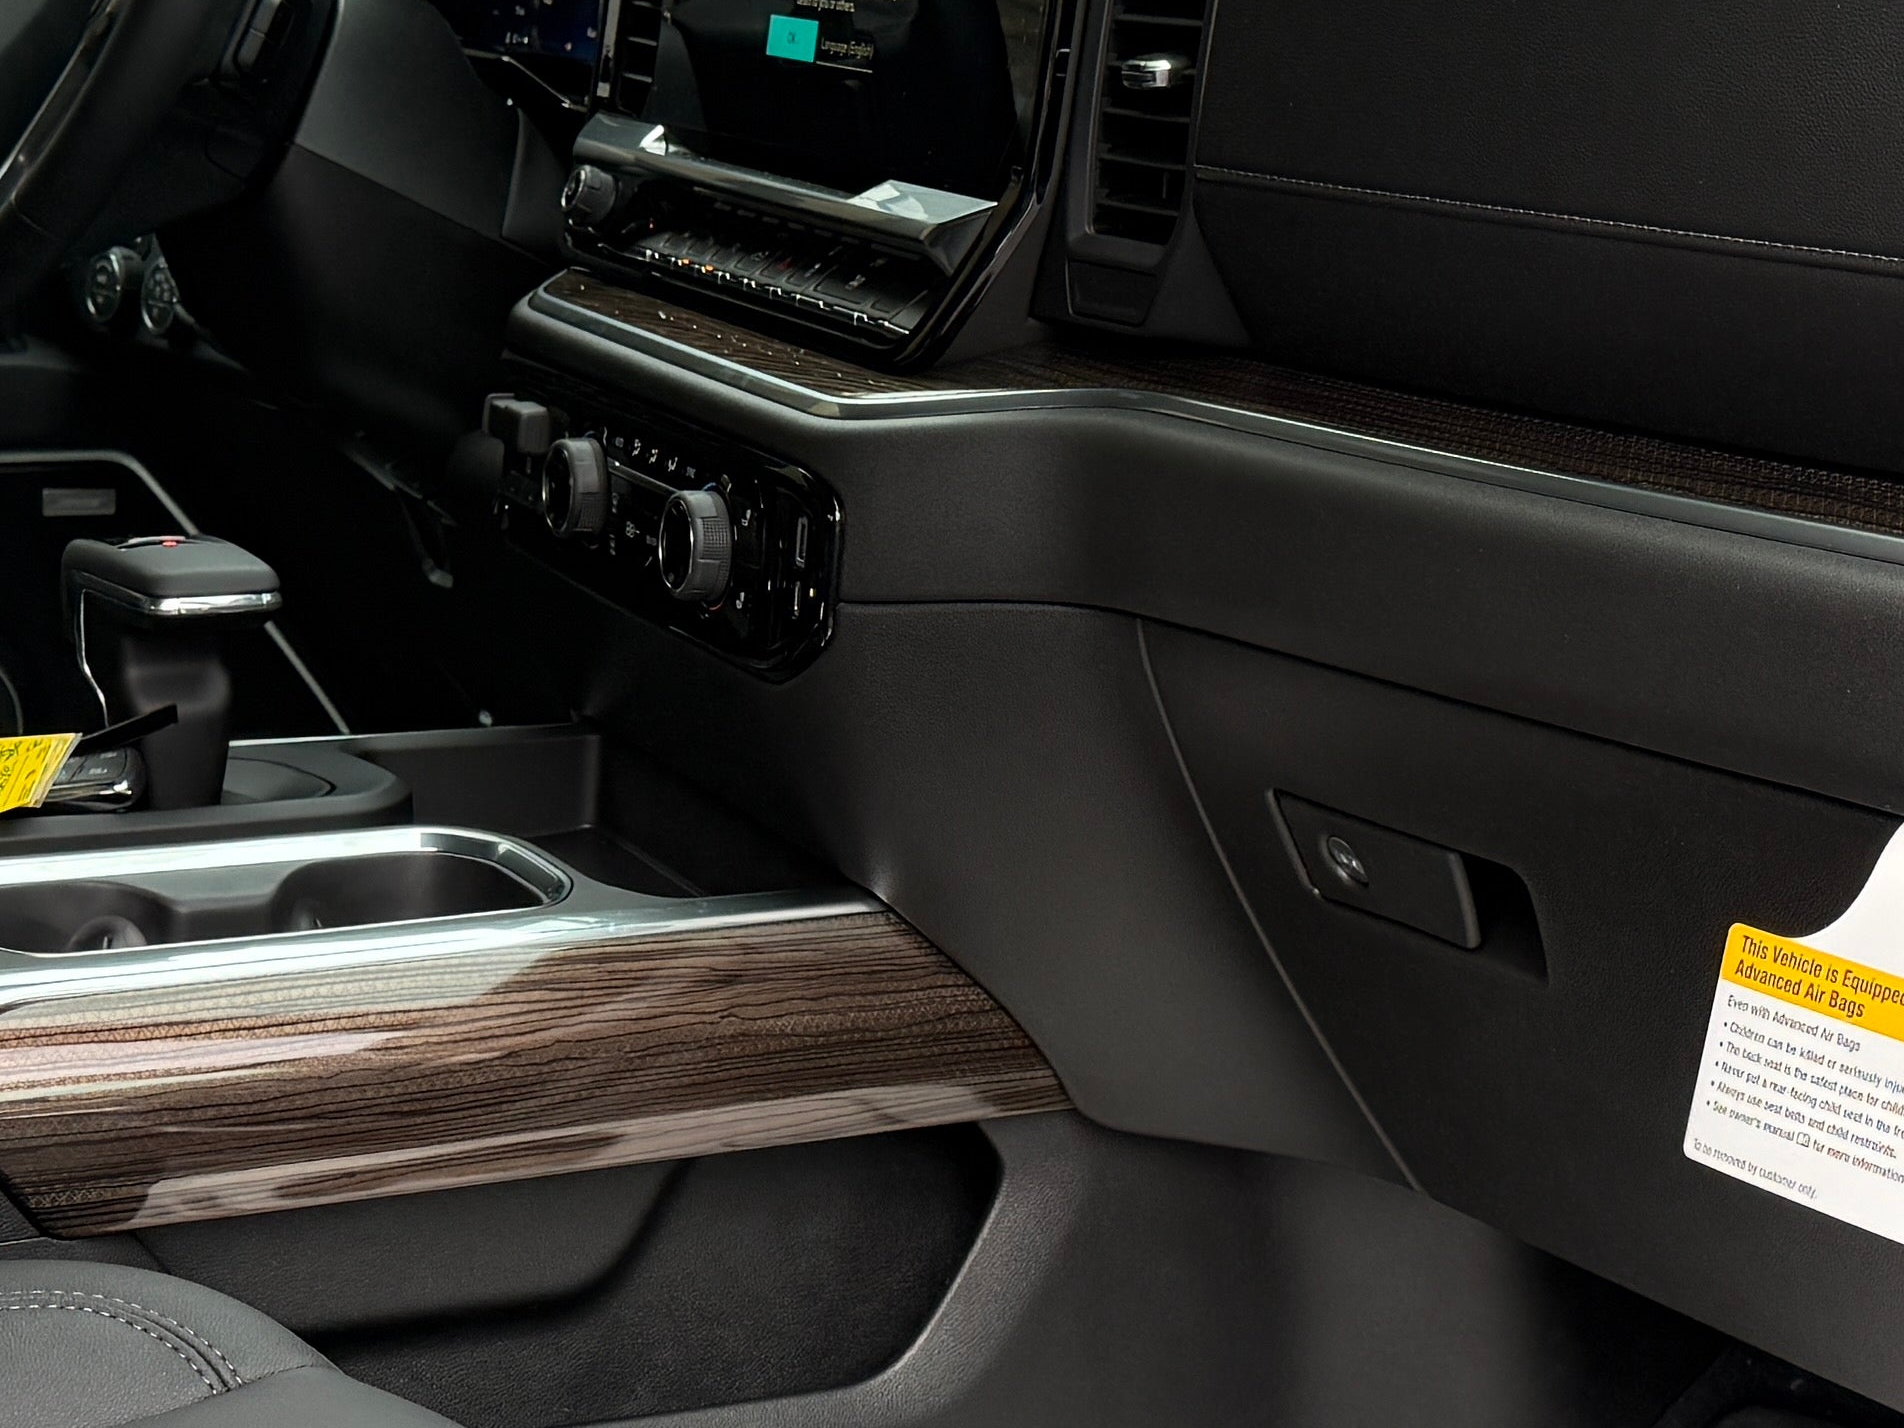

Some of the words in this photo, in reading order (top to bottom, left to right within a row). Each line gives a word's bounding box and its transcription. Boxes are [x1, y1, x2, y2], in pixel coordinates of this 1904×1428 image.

[1741, 934, 1769, 960] This
[1772, 944, 1823, 979] Vehicle
[1824, 963, 1839, 984] is
[1734, 958, 1803, 997] Advanced
[1803, 982, 1827, 1005] Air
[1828, 989, 1866, 1019] Bags
